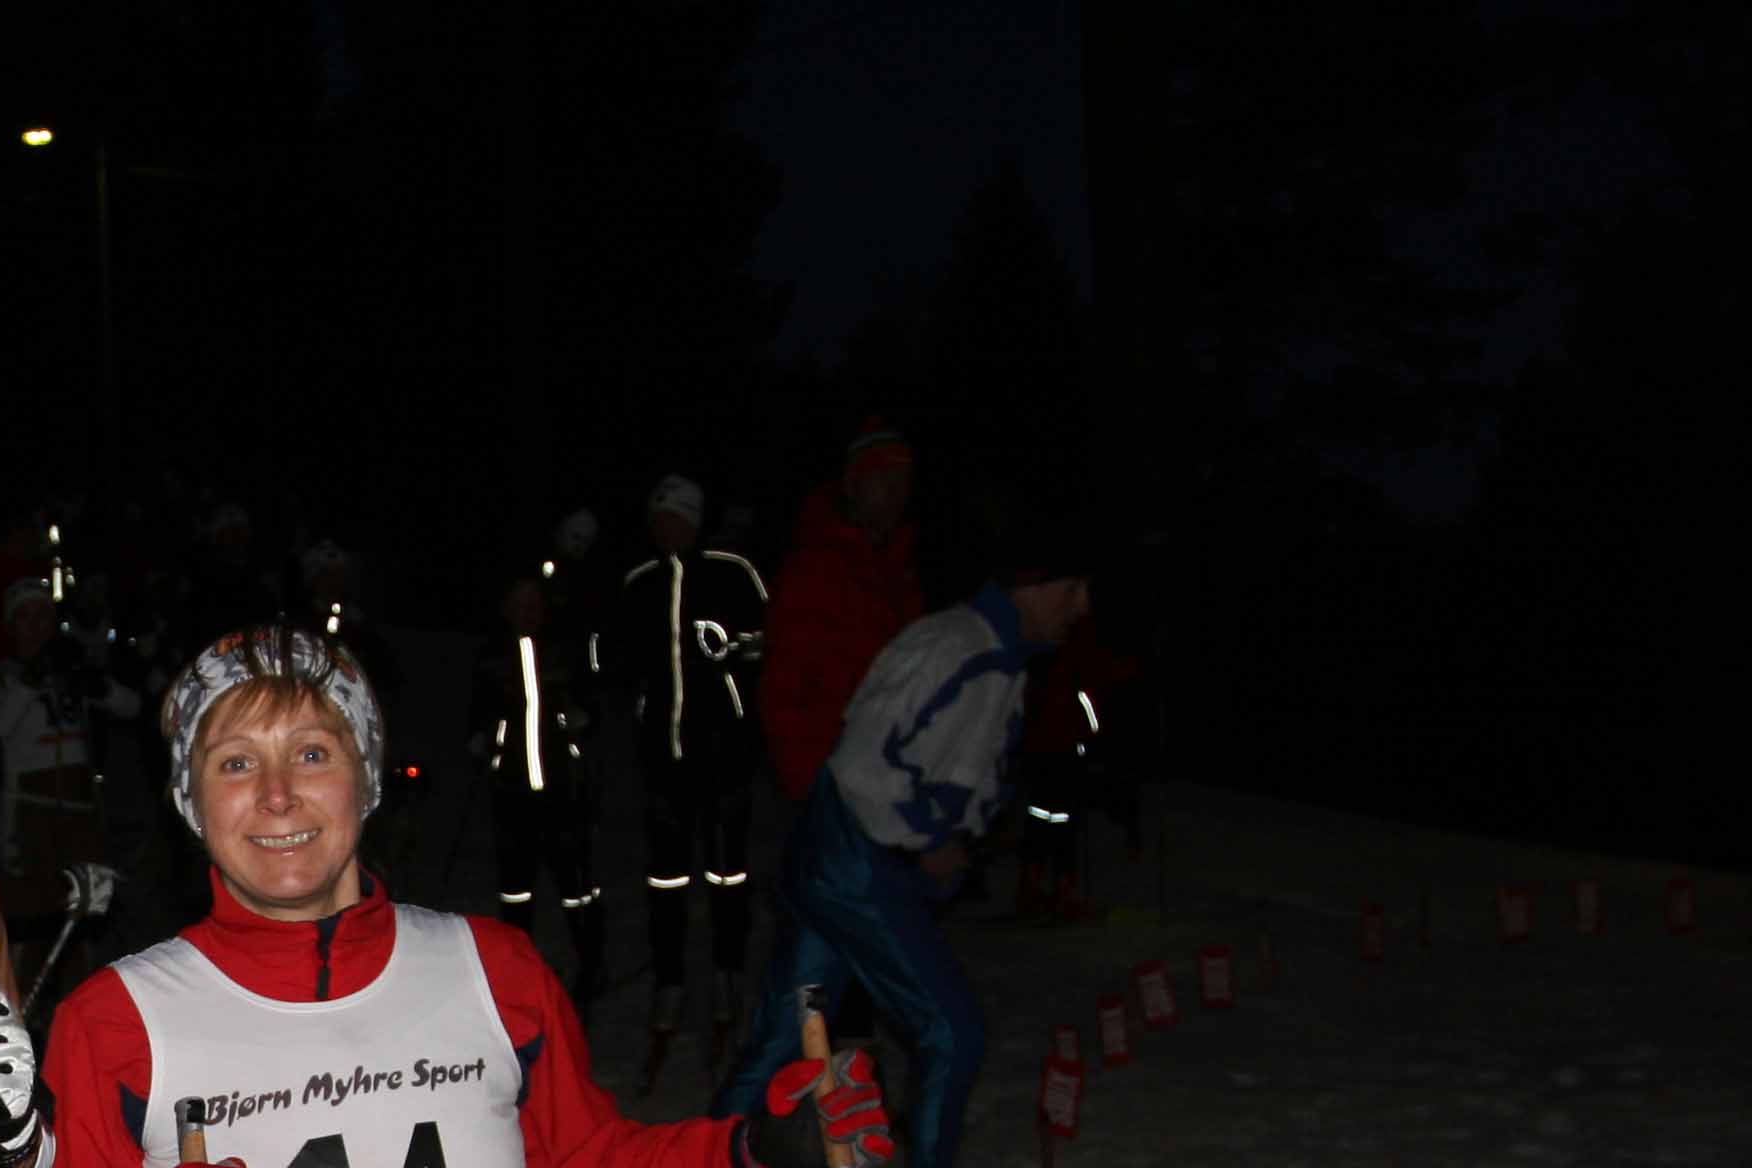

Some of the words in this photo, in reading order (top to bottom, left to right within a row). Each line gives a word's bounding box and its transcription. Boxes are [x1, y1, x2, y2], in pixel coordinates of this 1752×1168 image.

[204, 1089, 291, 1127] Bjørn
[303, 1066, 402, 1106] Myhre
[412, 1058, 485, 1090] Sport
